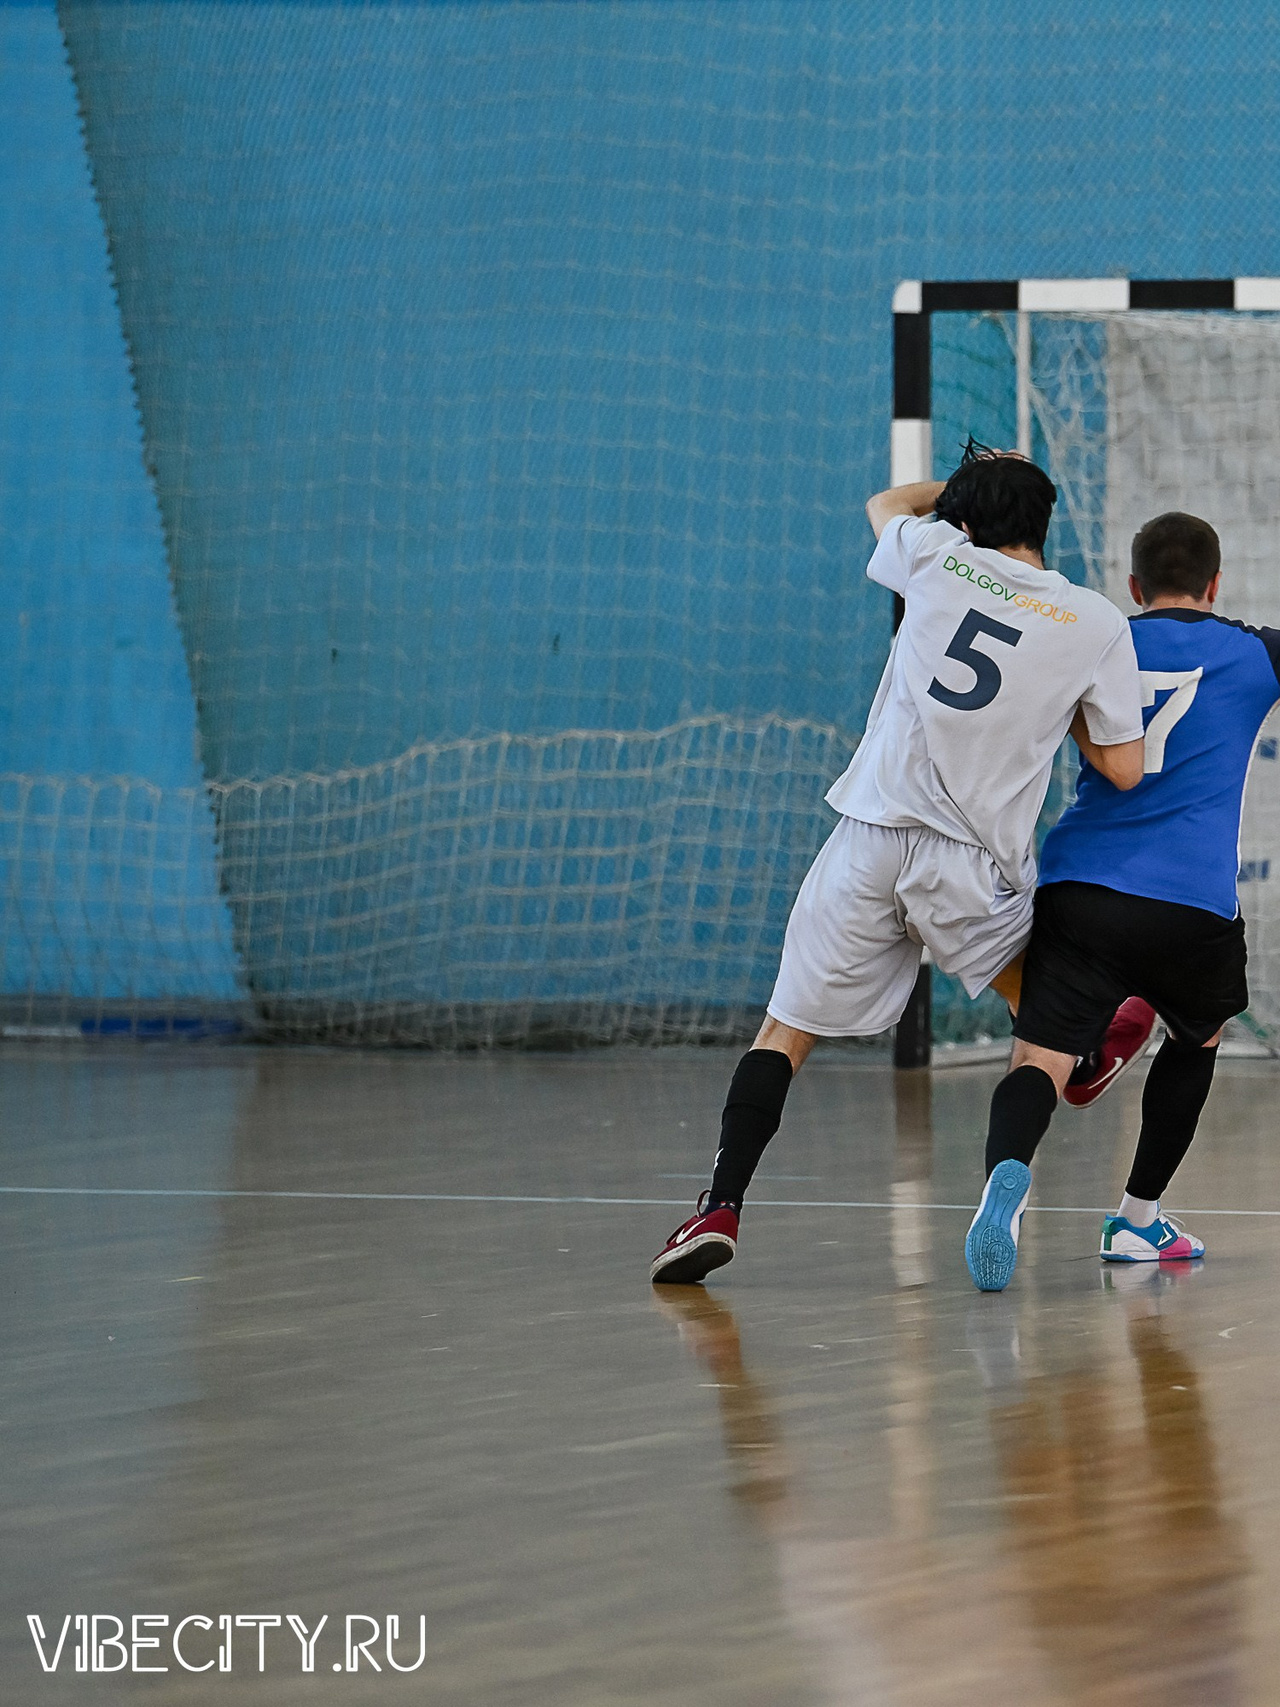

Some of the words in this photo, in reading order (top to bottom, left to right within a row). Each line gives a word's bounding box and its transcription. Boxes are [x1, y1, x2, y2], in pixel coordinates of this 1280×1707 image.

[942, 555, 1078, 625] DOLGOVGROUP
[926, 607, 1024, 711] 5
[1138, 666, 1204, 774] 7
